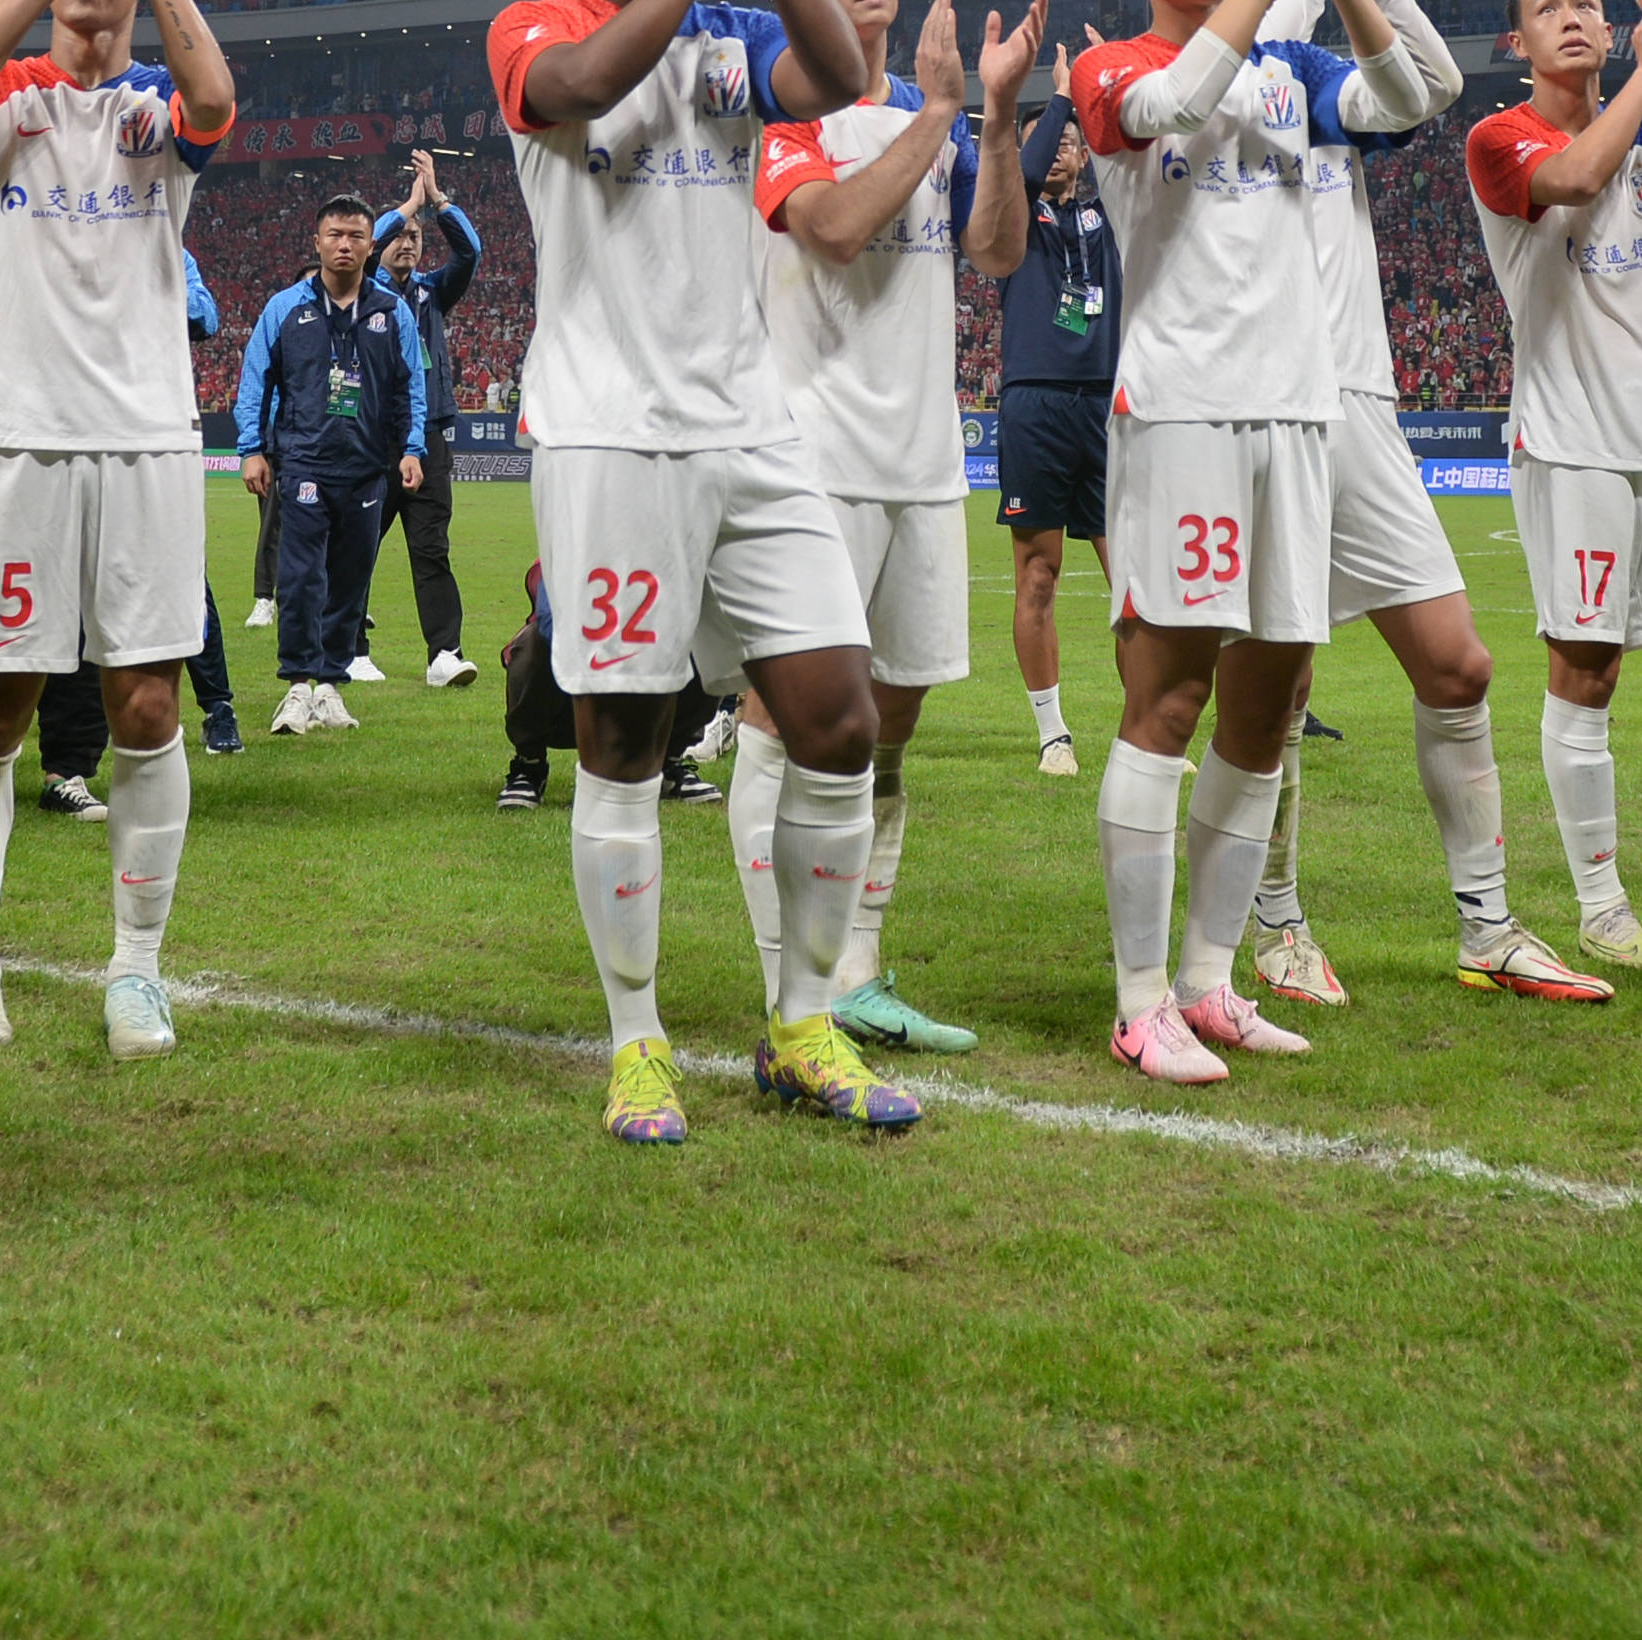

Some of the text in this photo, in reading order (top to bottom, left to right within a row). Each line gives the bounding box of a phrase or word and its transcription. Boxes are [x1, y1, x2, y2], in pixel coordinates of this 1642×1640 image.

[243, 120, 364, 153] 传承 热血
[392, 112, 447, 144] 忠诚
[616, 175, 650, 185] BANK
[31, 209, 63, 220] BANK
[45, 182, 165, 215] 交通銀行
[453, 454, 533, 476] FUTURES
[1010, 497, 1021, 509] LEE
[1176, 513, 1242, 583] 33
[1574, 549, 1616, 608] 17
[582, 567, 658, 644] 32
